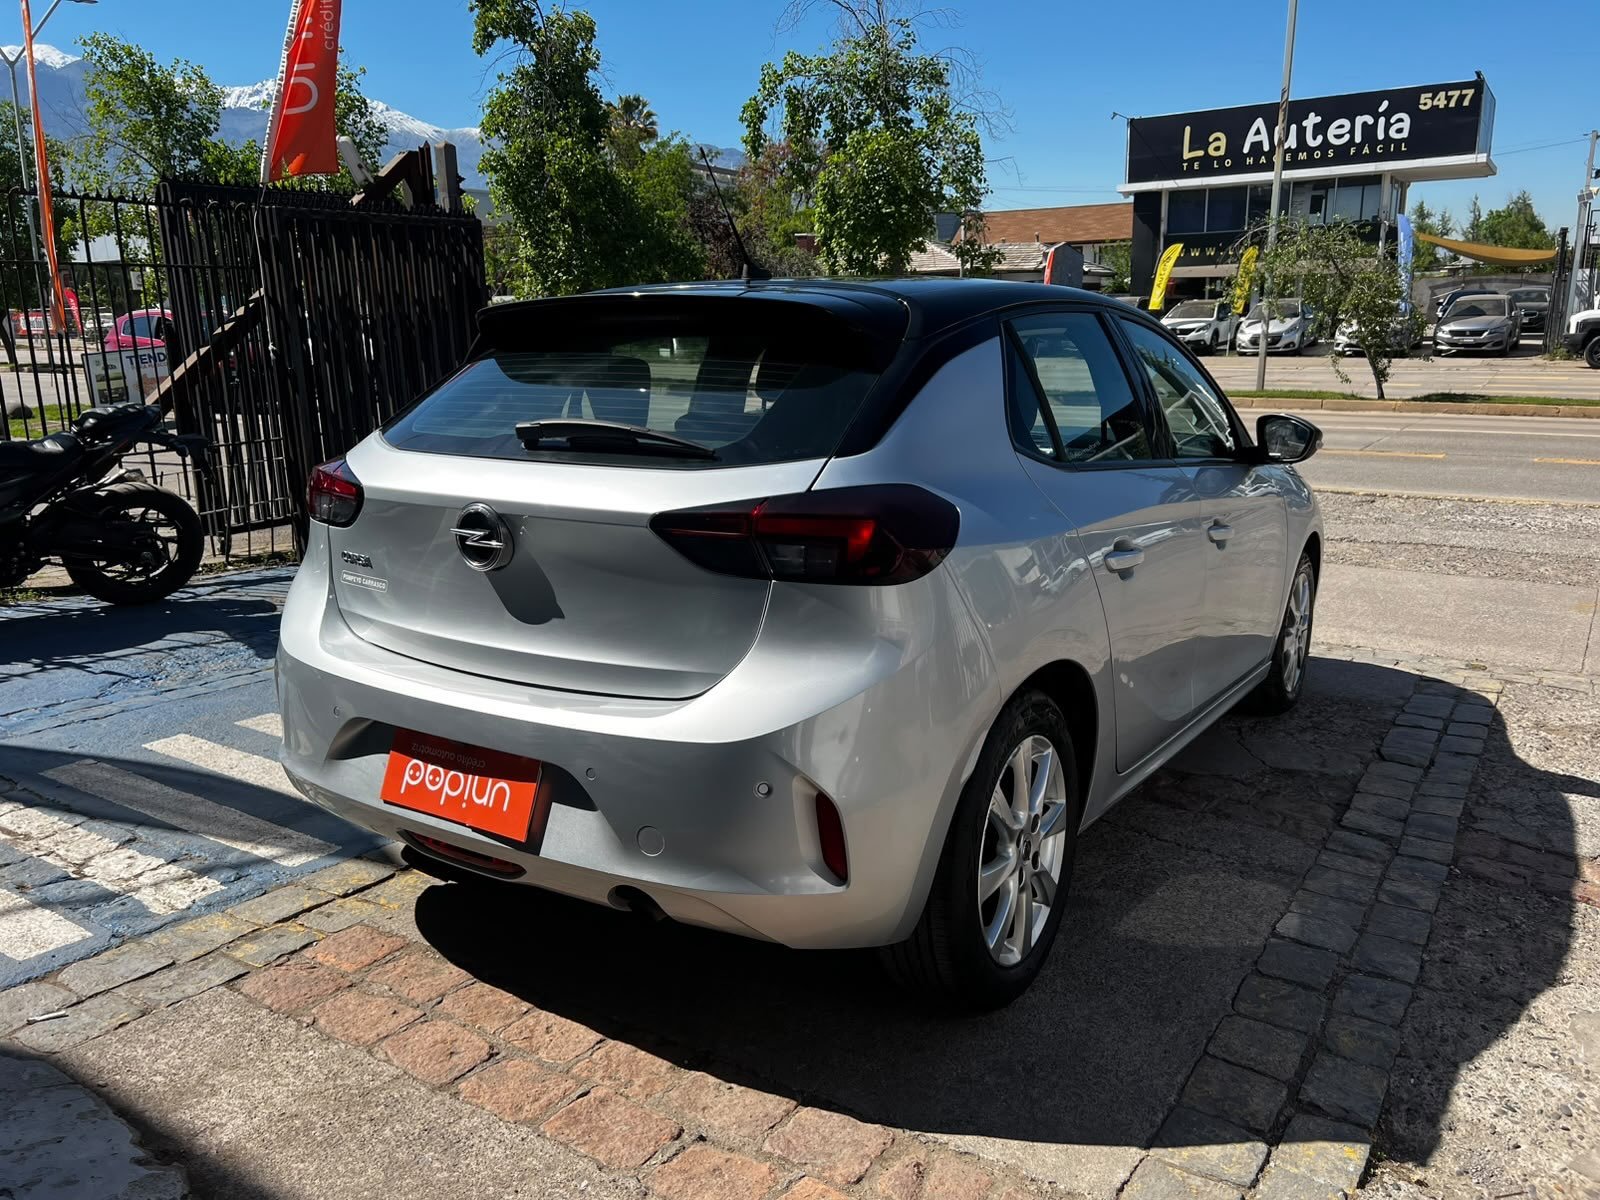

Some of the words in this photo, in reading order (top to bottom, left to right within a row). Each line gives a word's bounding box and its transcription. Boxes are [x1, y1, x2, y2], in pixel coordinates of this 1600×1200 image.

[1418, 89, 1475, 110] 5477
[1183, 126, 1227, 160] La
[1243, 100, 1411, 154] Autería
[1183, 161, 1200, 171] TE
[1214, 159, 1232, 168] LO
[1350, 142, 1408, 156] FÁCIL
[400, 759, 511, 812] unidad
